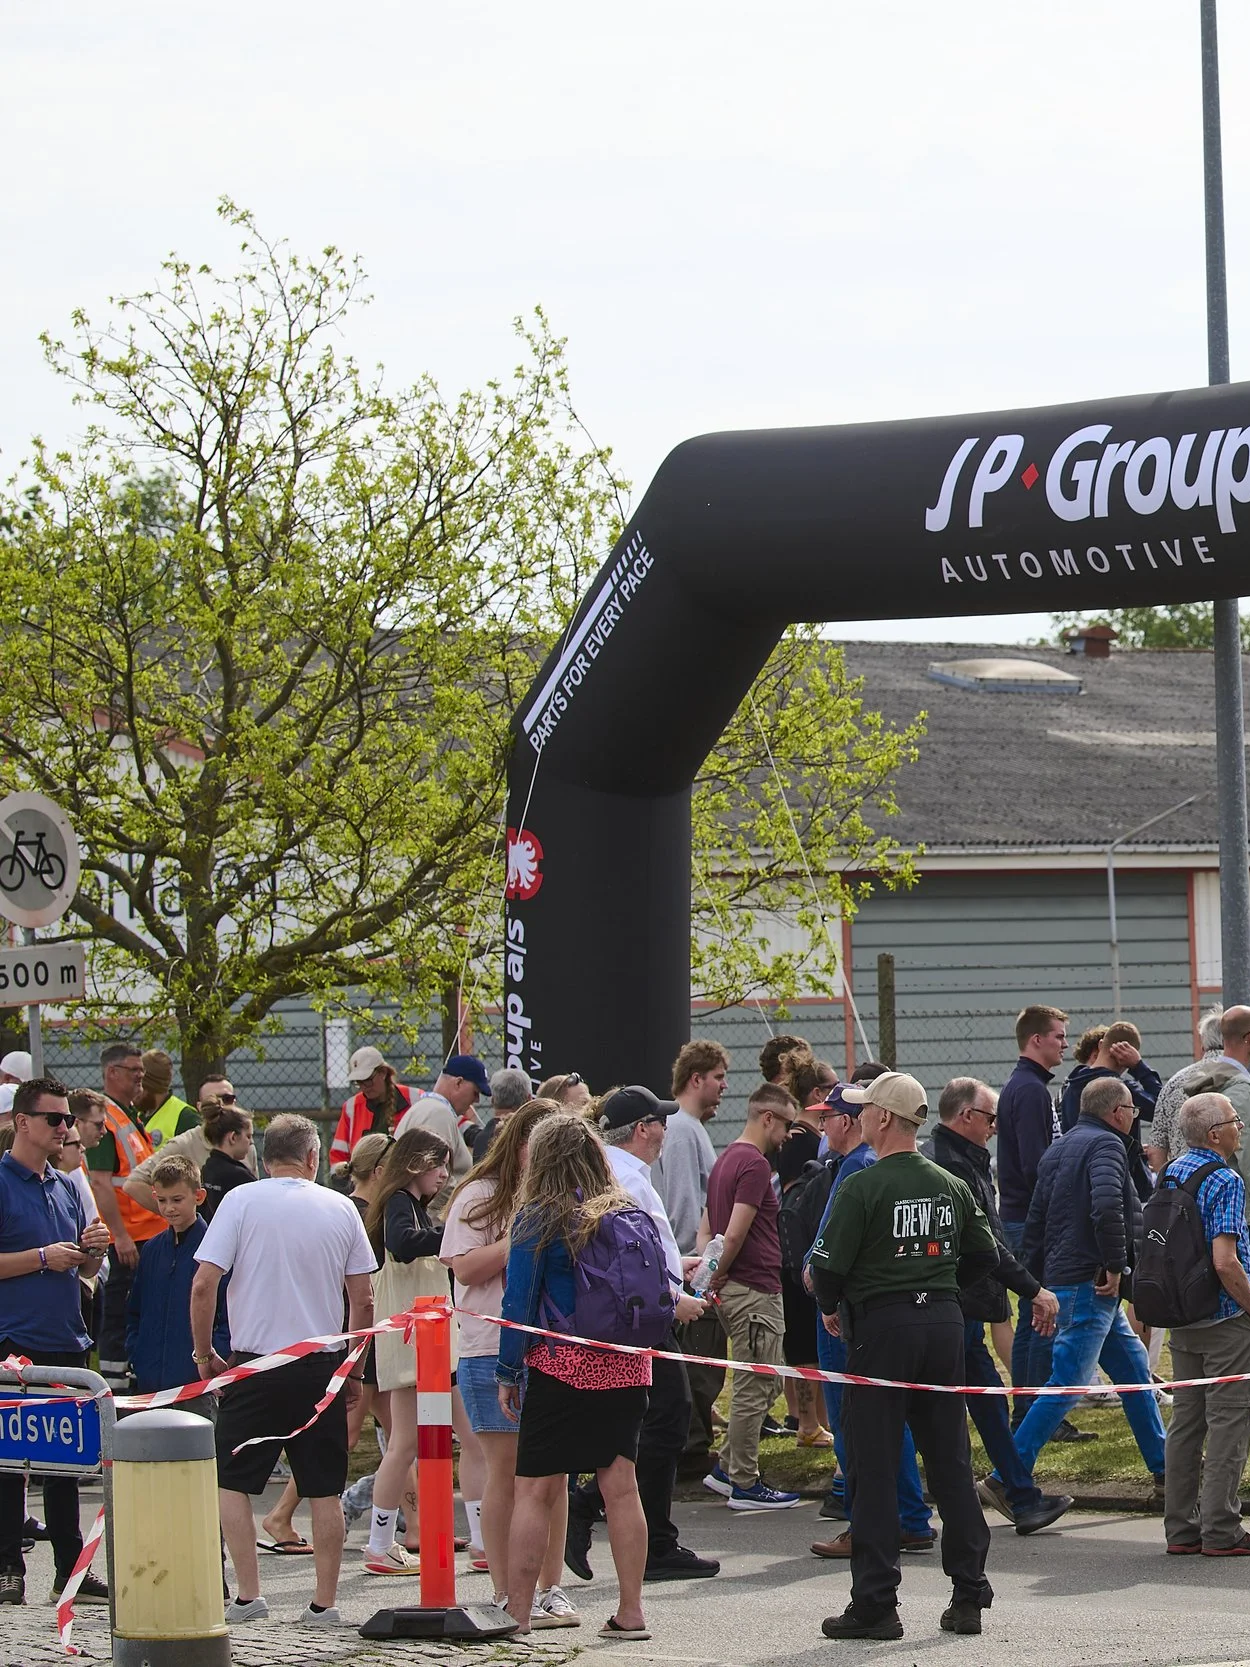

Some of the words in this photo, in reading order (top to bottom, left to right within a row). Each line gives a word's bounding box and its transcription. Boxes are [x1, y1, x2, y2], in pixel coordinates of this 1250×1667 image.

[941, 535, 1216, 585] AUTOMOTIVE
[529, 691, 568, 755] PARTS
[561, 653, 591, 698] FOR
[584, 593, 625, 661] EVERY
[619, 546, 655, 603] PACE
[60, 964, 77, 984] m
[893, 1203, 932, 1238] CREW
[0, 1406, 84, 1453] dsvej
